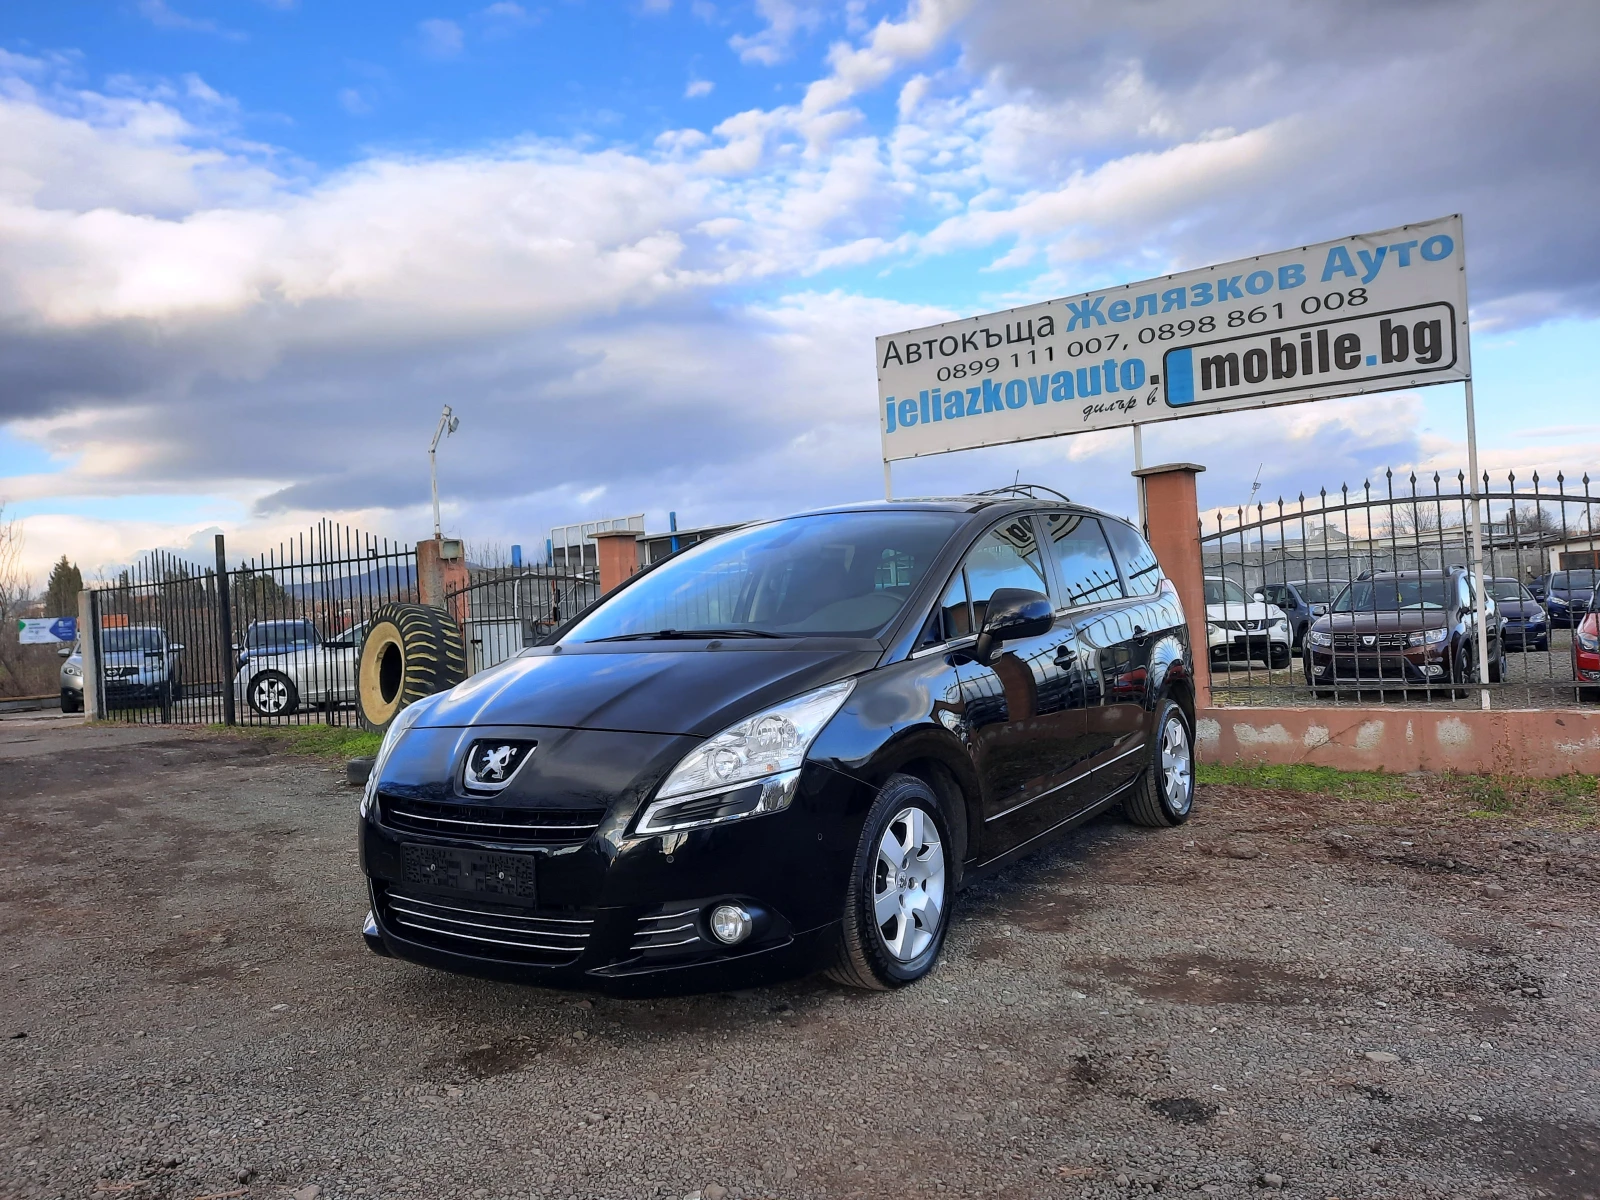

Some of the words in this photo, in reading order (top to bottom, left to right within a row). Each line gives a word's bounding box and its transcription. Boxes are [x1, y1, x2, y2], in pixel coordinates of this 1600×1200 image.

[882, 315, 1055, 369] Автокъща
[1065, 263, 1307, 333] Желязков
[1320, 234, 1454, 285] Ауто
[936, 357, 1000, 382] 0899
[1010, 346, 1054, 368] 111
[1067, 333, 1129, 358] 007,
[1138, 315, 1216, 344] 0898
[1227, 302, 1284, 328] 861
[1300, 287, 1369, 315] 008
[1200, 318, 1443, 391] mobile.bg
[1082, 395, 1138, 422] дилър
